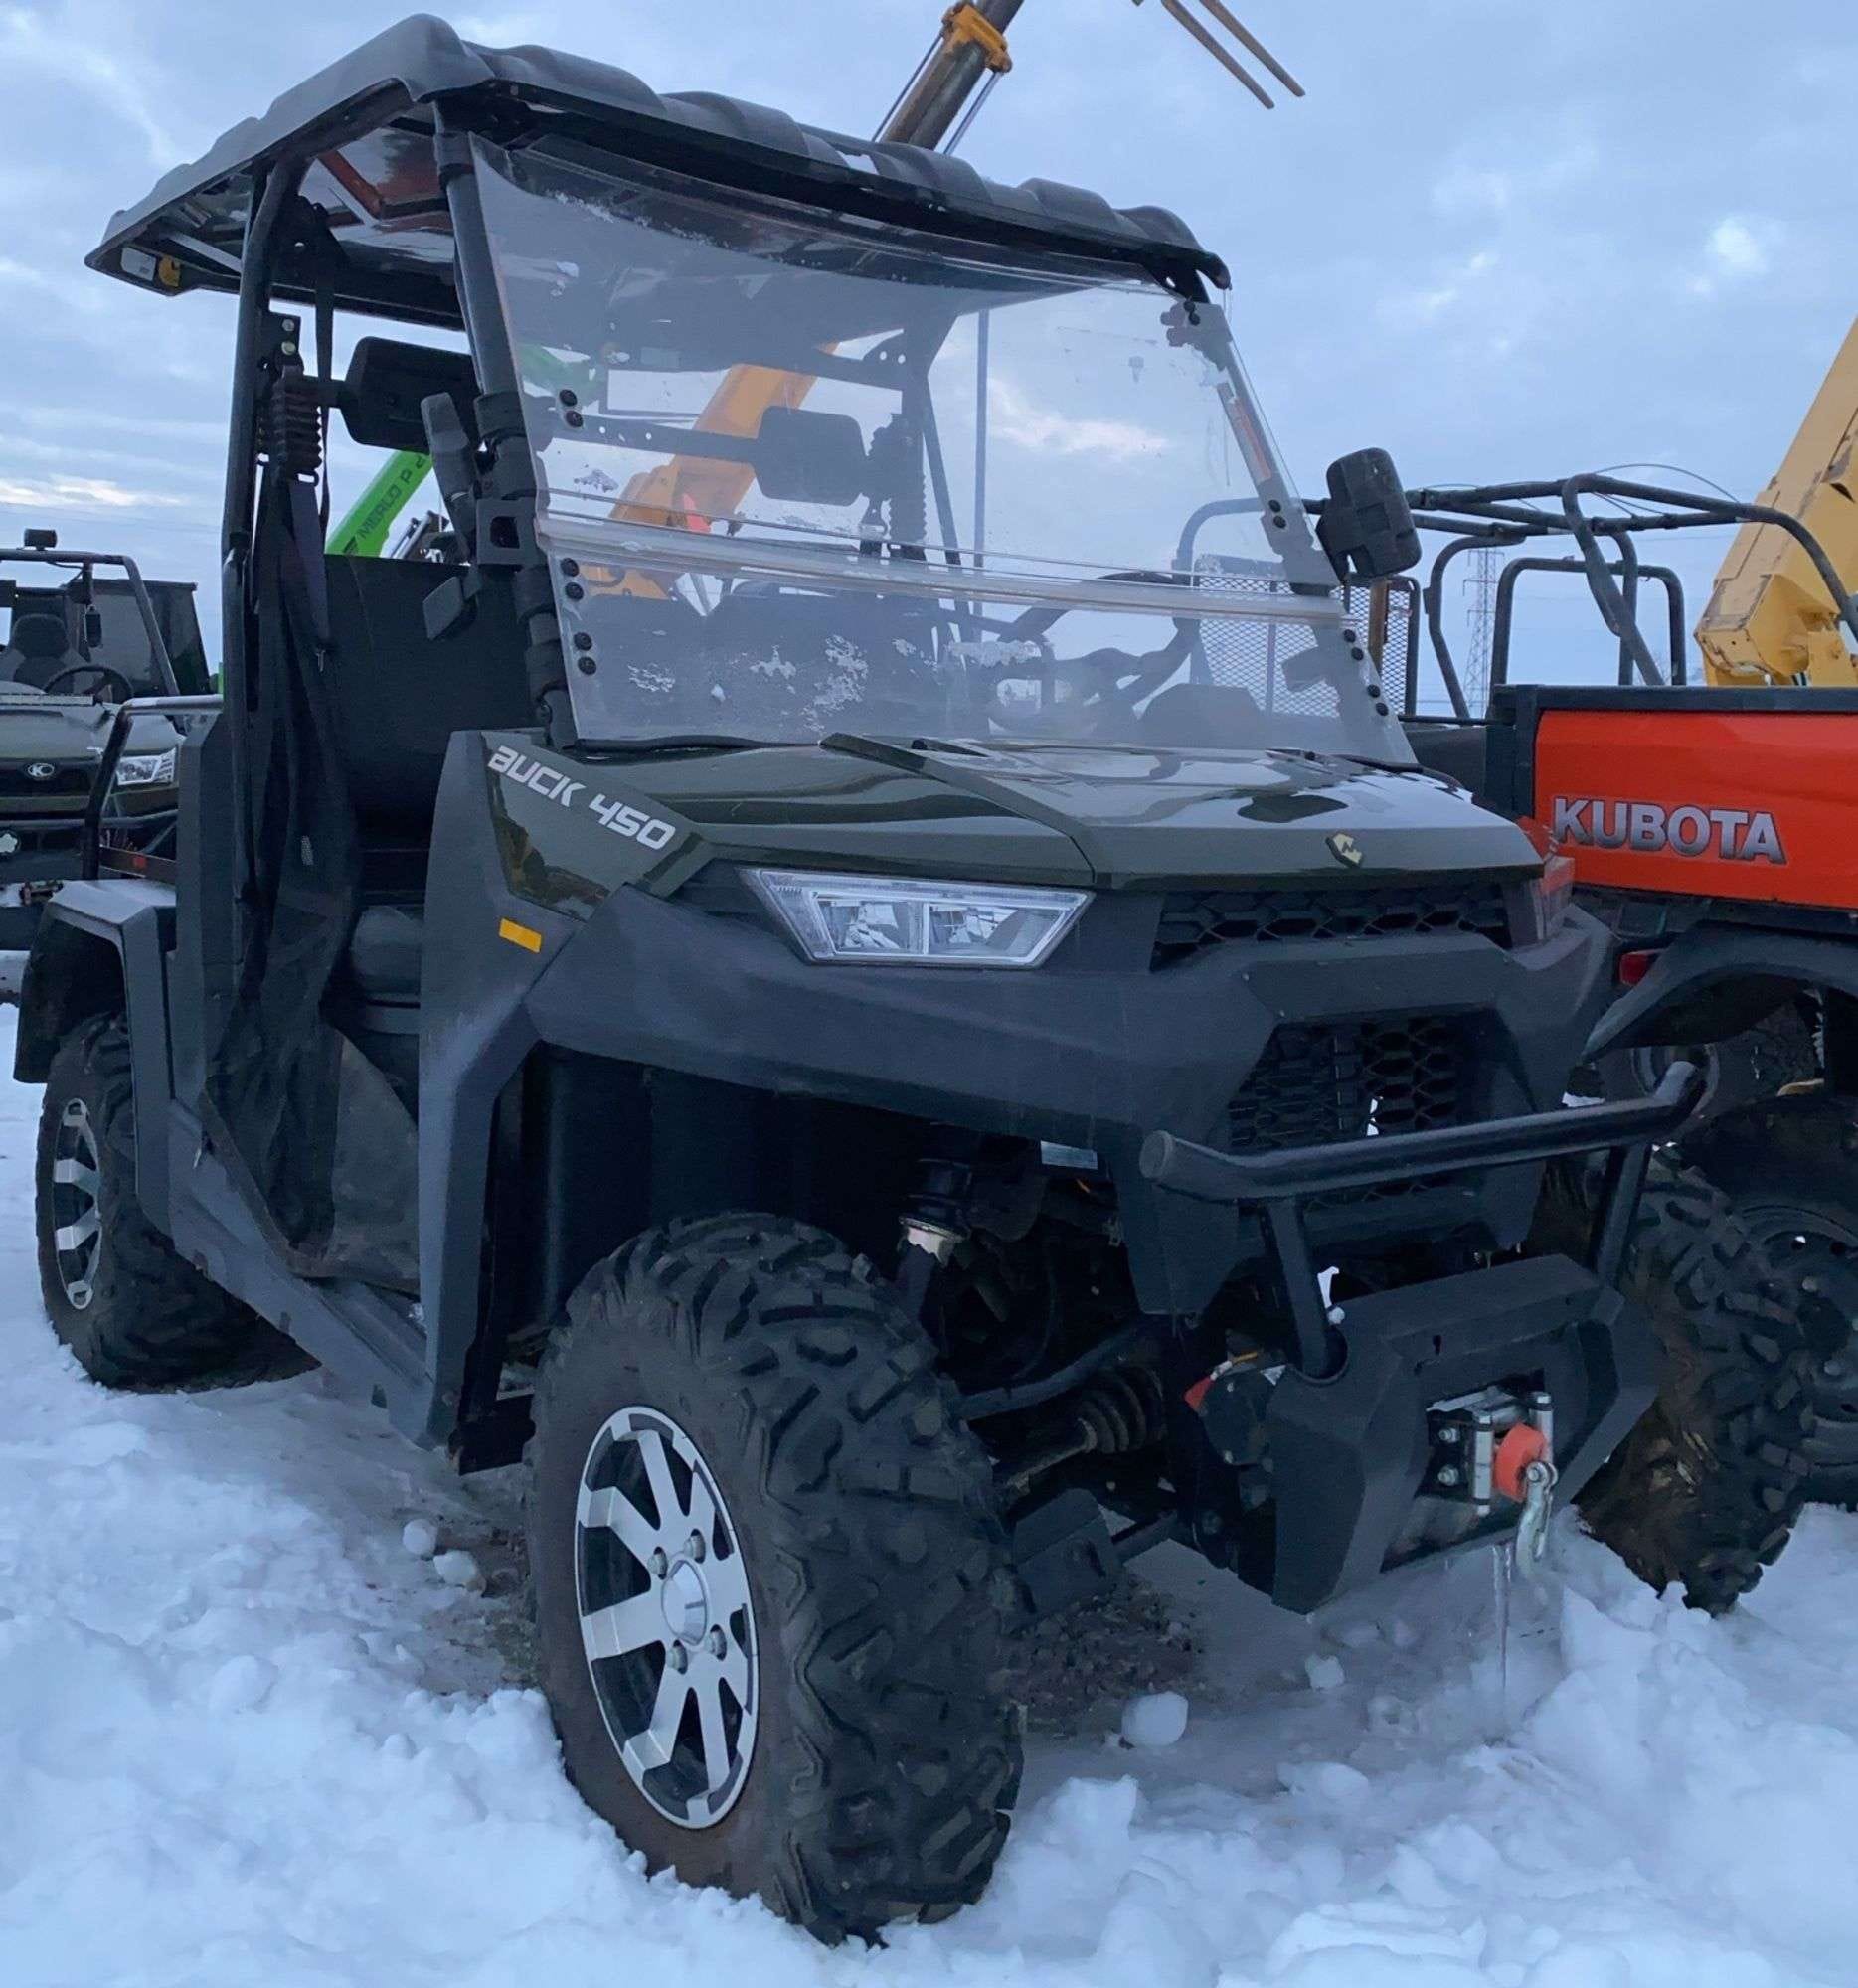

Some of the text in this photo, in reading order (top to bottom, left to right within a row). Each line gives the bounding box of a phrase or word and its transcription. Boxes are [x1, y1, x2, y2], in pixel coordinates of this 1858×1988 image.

[487, 746, 676, 850] BUCK 450
[1553, 796, 1787, 865] KUBOTA
